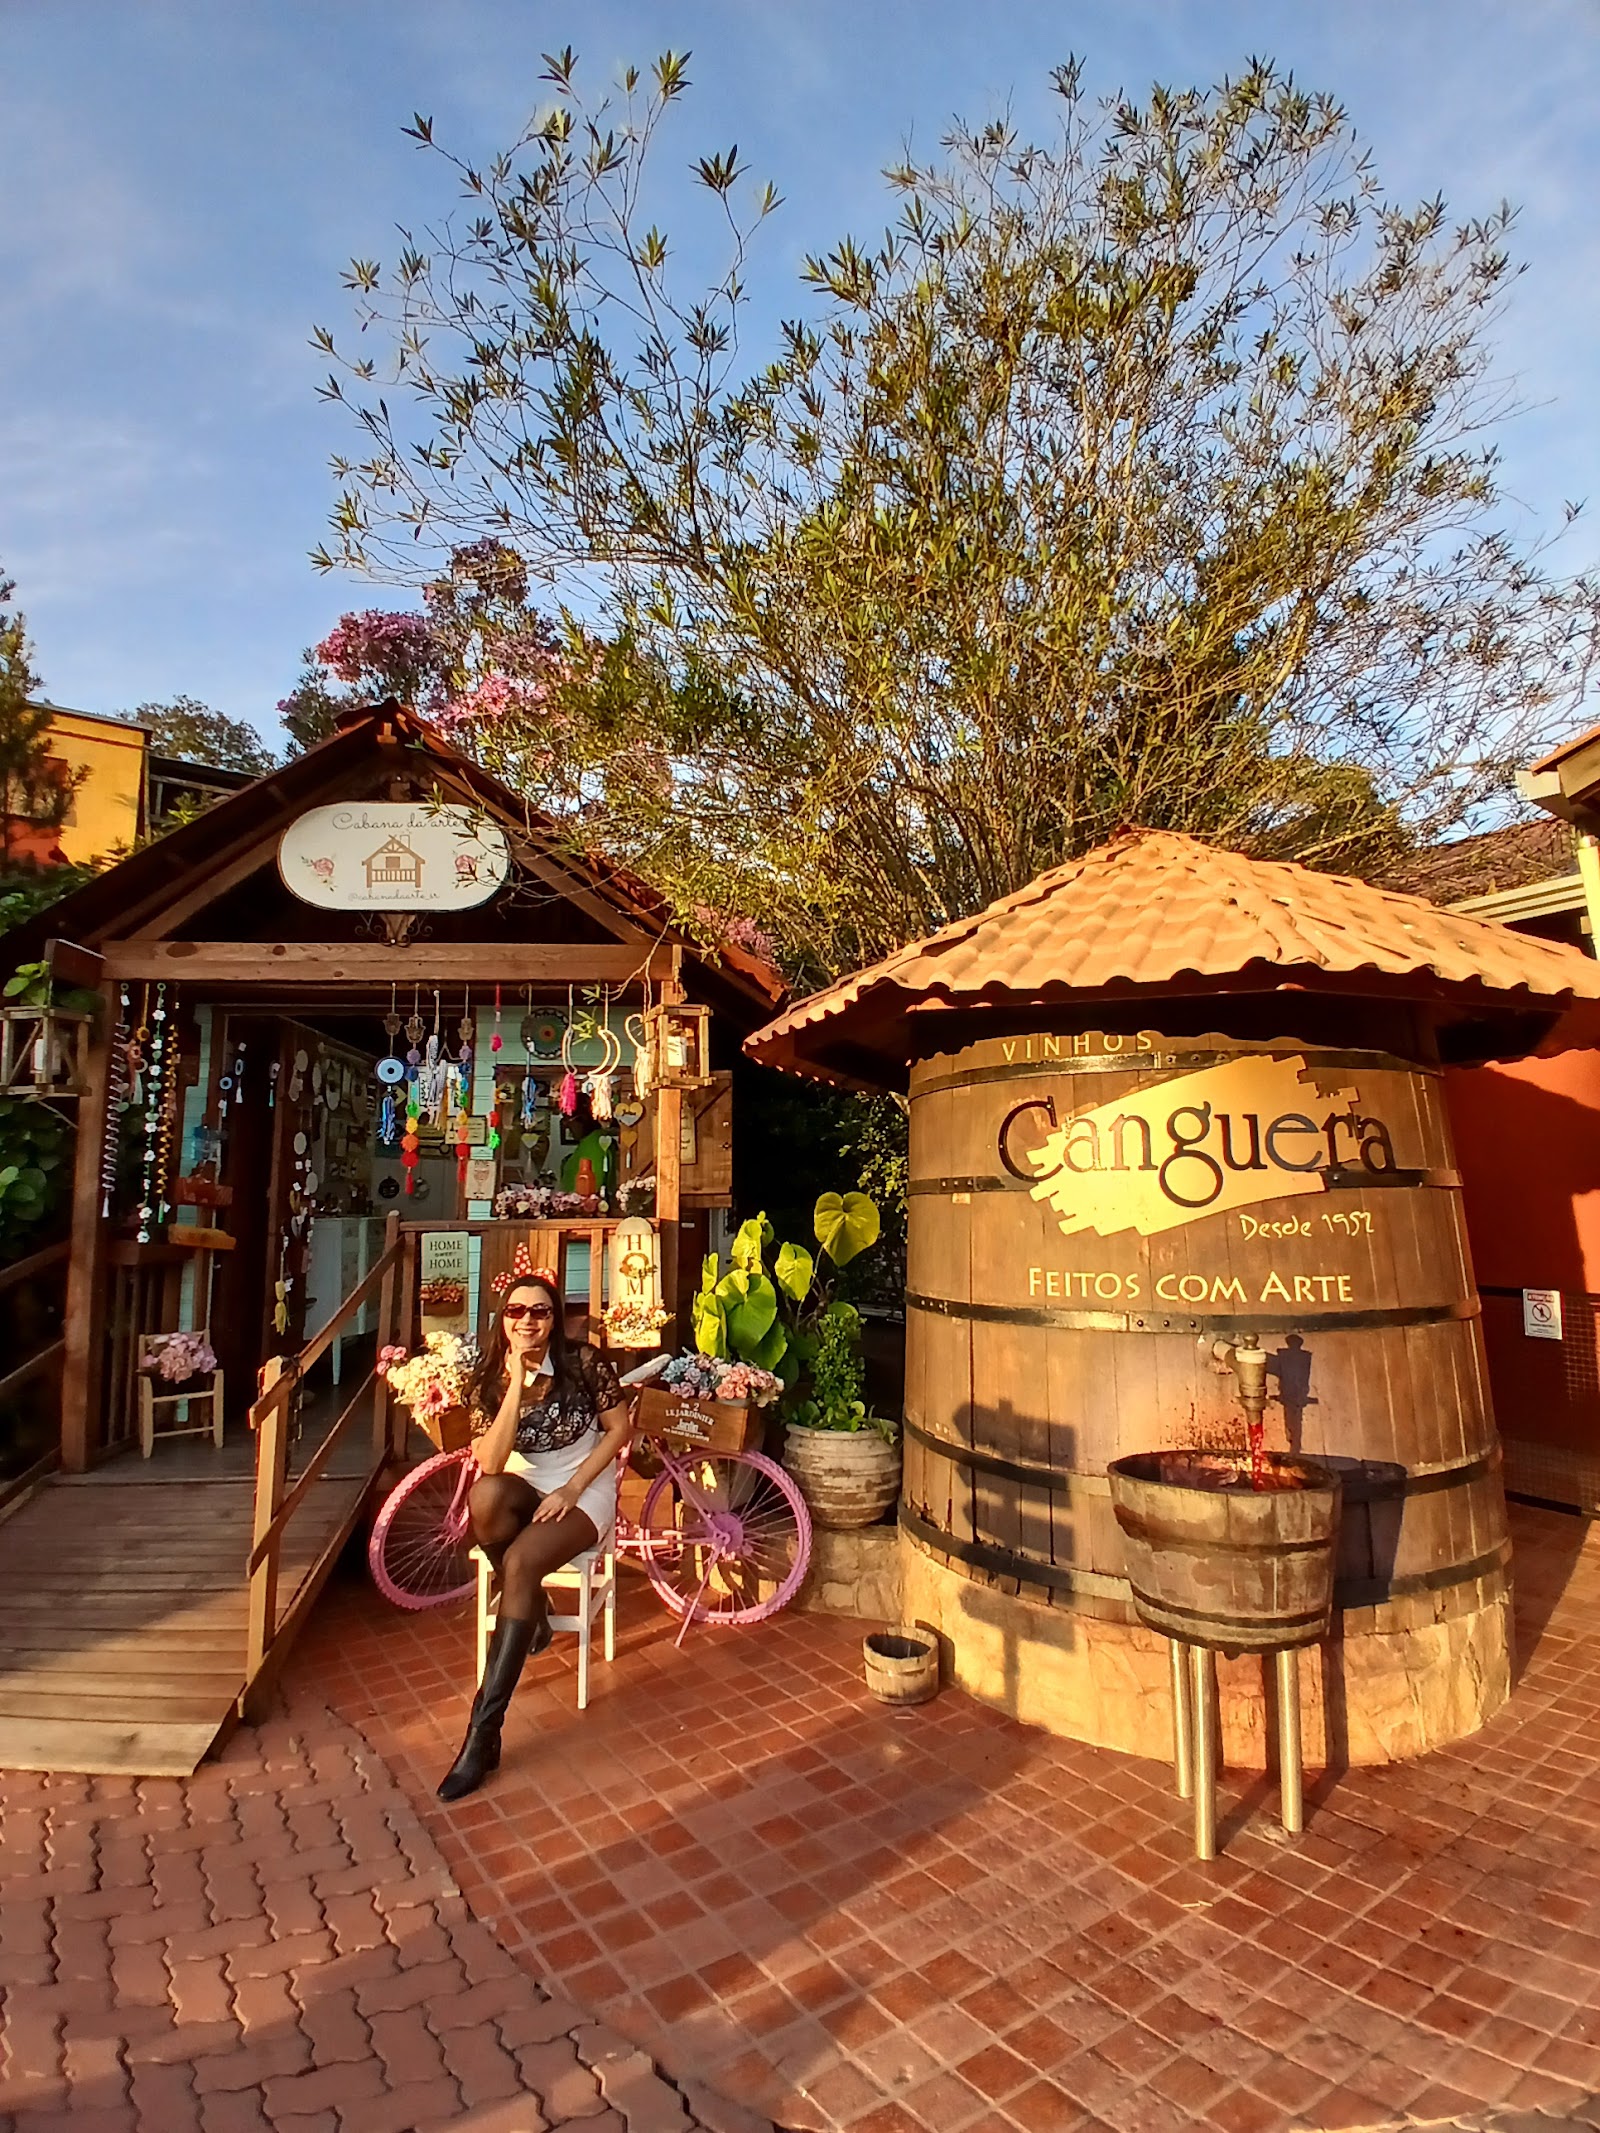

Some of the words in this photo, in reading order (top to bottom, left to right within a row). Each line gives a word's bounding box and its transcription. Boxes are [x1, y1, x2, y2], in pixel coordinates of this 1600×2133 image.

[332, 812, 403, 830] Cabana
[407, 812, 426, 828] da
[1002, 1030, 1152, 1062] VINHOS
[998, 1096, 1397, 1208] Canguera
[1239, 1214, 1312, 1241] Desde
[1321, 1211, 1375, 1237] 1952
[430, 1240, 463, 1251] HOME
[430, 1258, 463, 1269] HOME
[1028, 1266, 1140, 1300] FEITOS
[1260, 1270, 1354, 1303] ARTE
